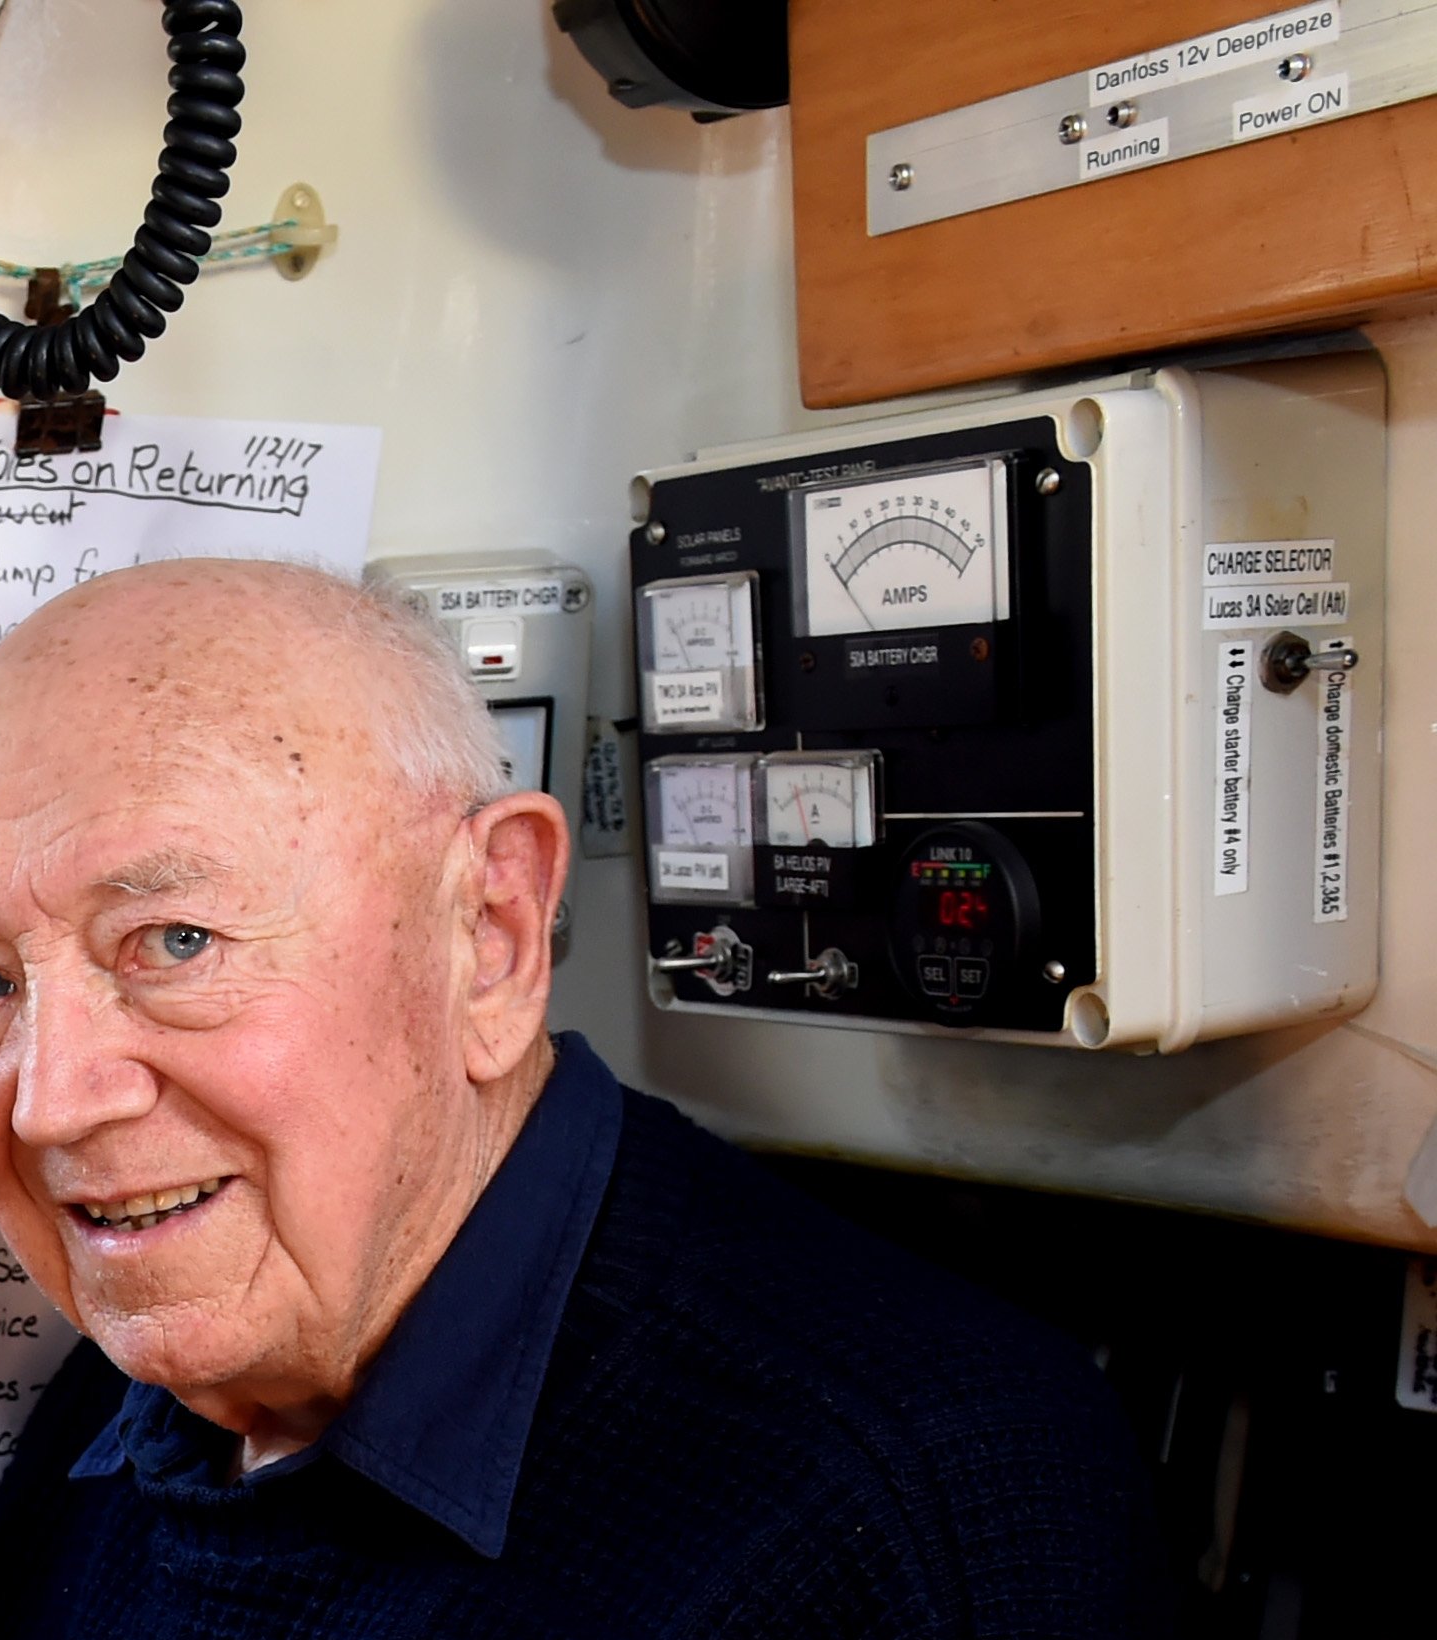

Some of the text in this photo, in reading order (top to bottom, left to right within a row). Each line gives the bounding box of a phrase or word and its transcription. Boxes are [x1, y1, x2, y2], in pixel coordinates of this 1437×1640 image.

[1095, 9, 1333, 92] Danfoss 12v Deepfreeze
[1238, 87, 1342, 133] Power ON
[1086, 134, 1161, 170] Running
[72, 460, 117, 486] on
[128, 444, 309, 500] Returning
[1207, 547, 1332, 575] CHARGE SELECTOR
[466, 588, 519, 609] BATTERY
[523, 586, 560, 606] CHGR
[882, 585, 928, 605] AMPS
[1209, 595, 1243, 619] Lucas
[1246, 594, 1262, 617] 3A
[1265, 594, 1295, 617] Solar
[1296, 592, 1318, 615] Cell
[866, 647, 908, 667] BATTERY
[1223, 674, 1244, 725] Charge
[1324, 671, 1346, 722] Charge
[1225, 727, 1241, 773] starter
[1325, 725, 1343, 786] domestic
[1220, 776, 1241, 824] battery
[1323, 789, 1342, 849] Batteries
[930, 847, 957, 861] LINK
[1220, 848, 1237, 876] only
[924, 967, 946, 982] SEL
[960, 969, 982, 984] SET
